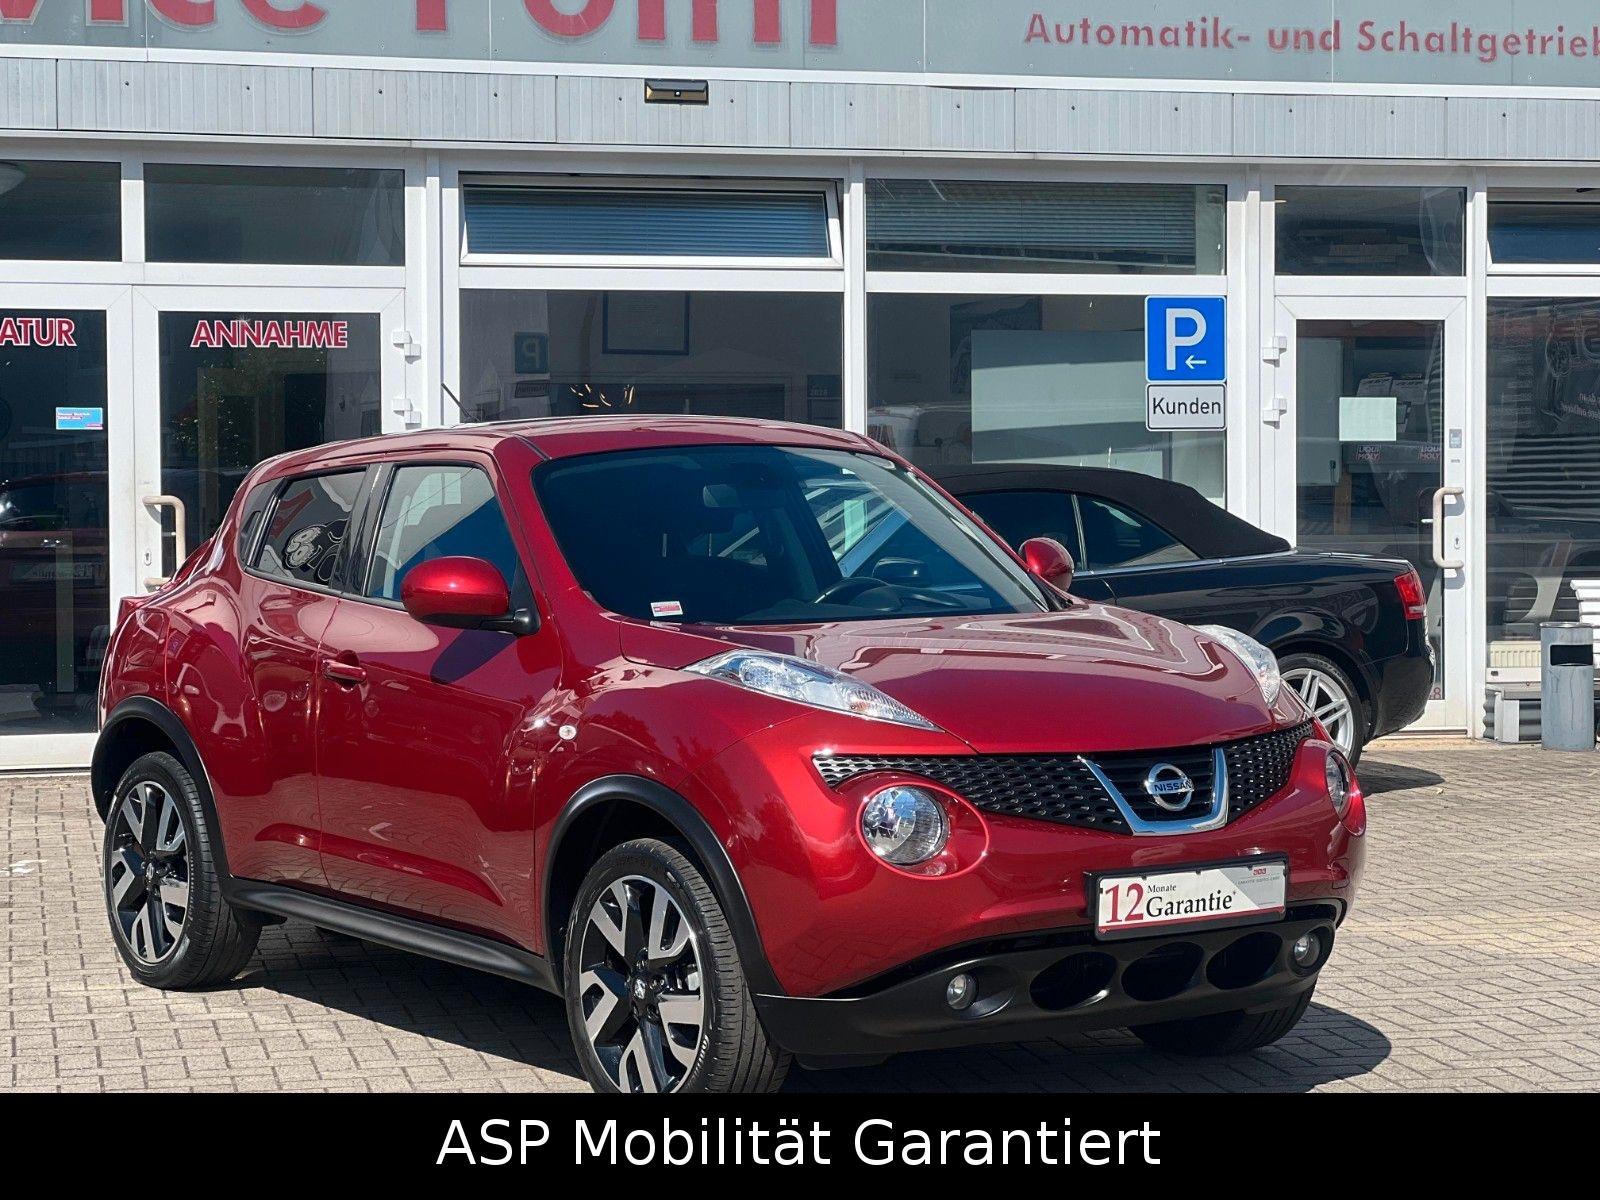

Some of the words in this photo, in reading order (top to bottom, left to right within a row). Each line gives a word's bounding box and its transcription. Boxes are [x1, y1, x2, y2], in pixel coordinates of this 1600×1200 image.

[1024, 13, 1250, 49] Automatik-
[1267, 20, 1340, 51] und
[0, 317, 77, 346] ATUR
[189, 320, 348, 348] ANNAHME
[1165, 307, 1207, 371] P
[1152, 397, 1221, 415] Kunden
[1153, 779, 1192, 792] NISSAN
[1105, 883, 1144, 924] 12
[1147, 884, 1177, 893] Monate
